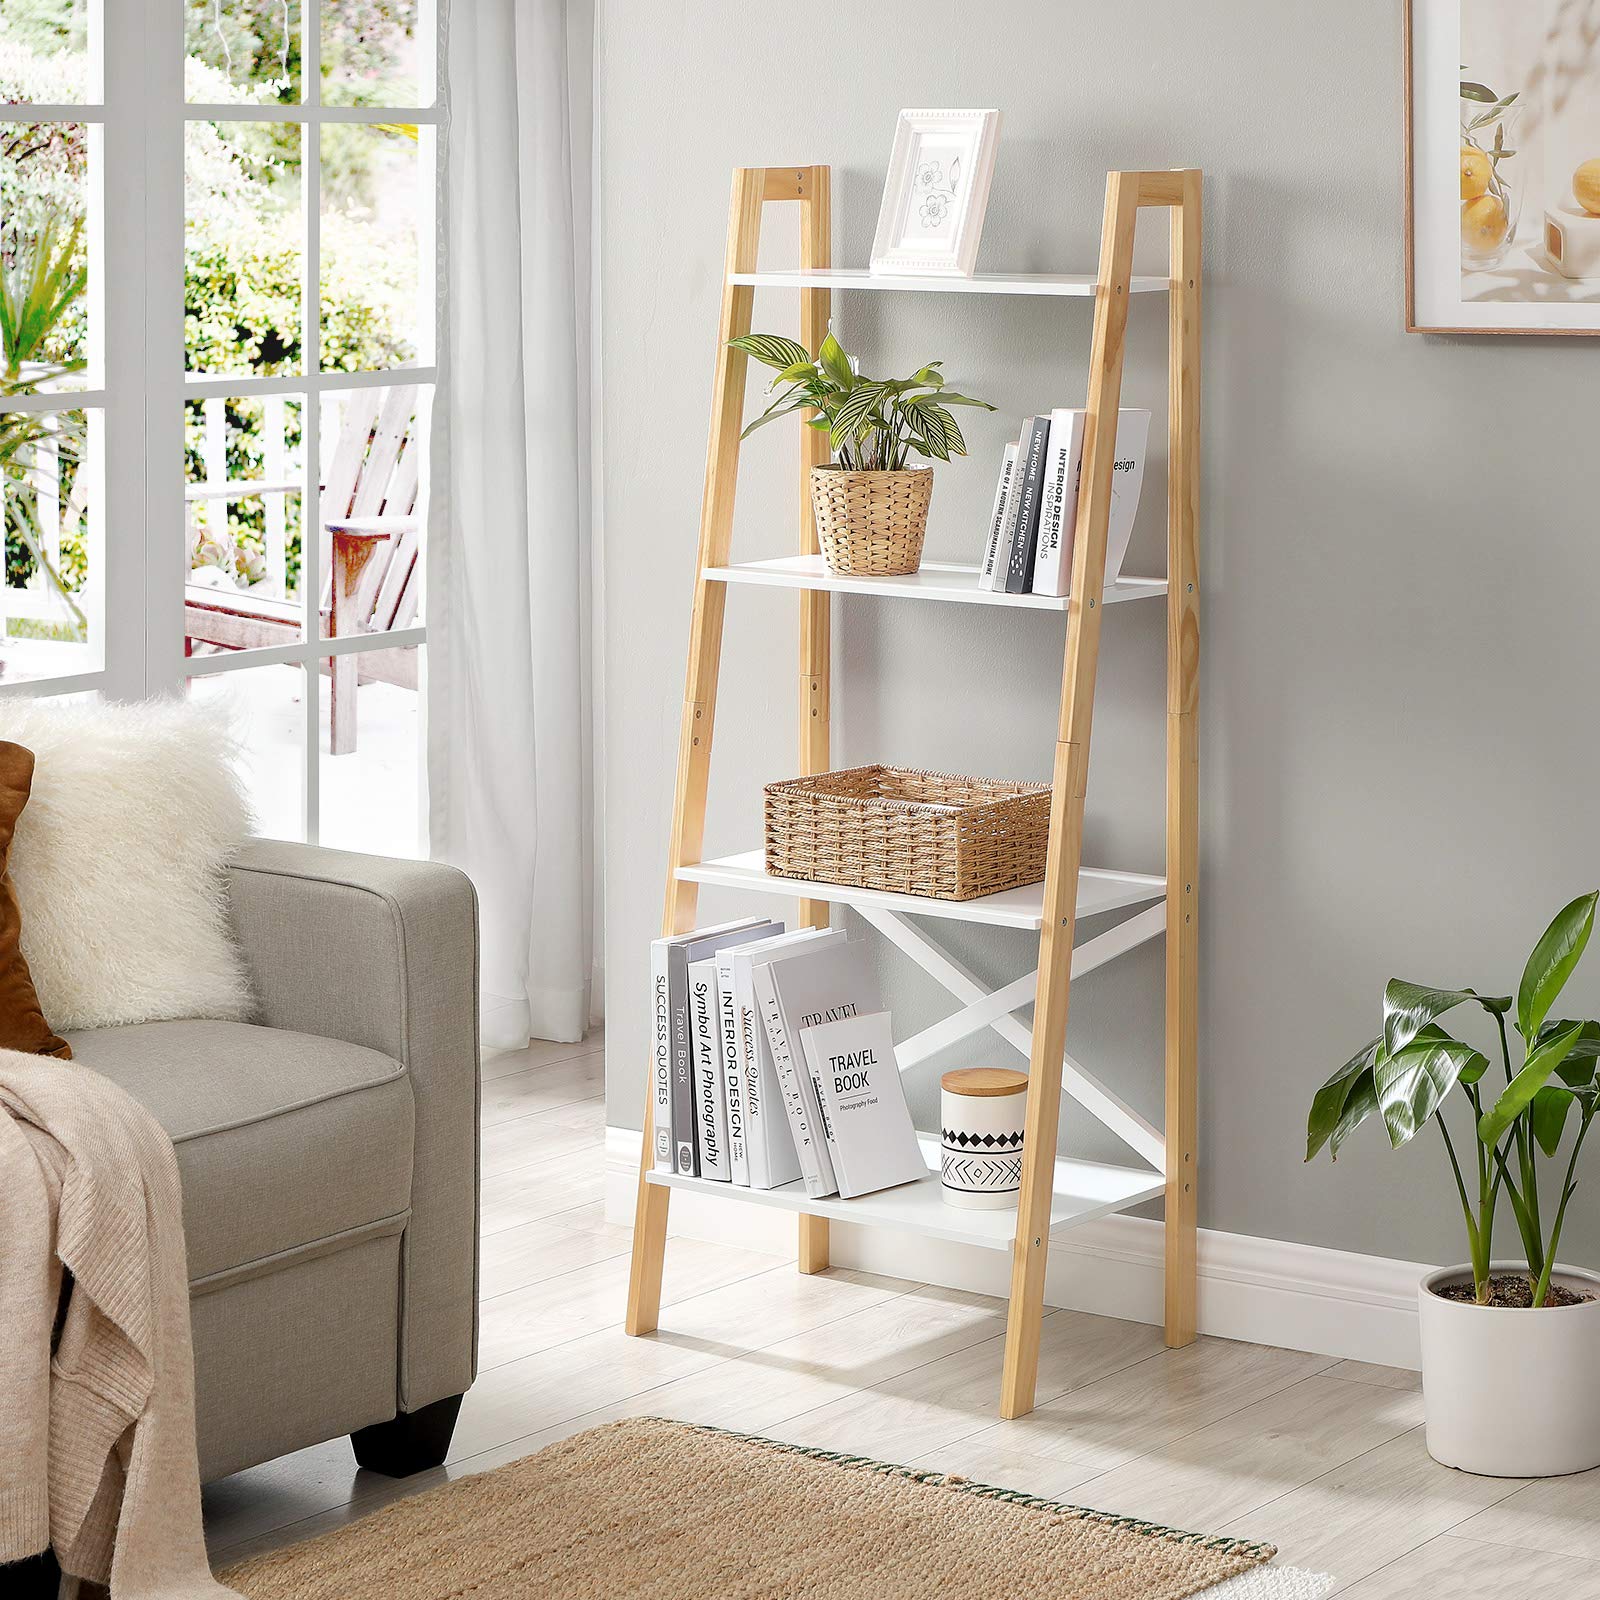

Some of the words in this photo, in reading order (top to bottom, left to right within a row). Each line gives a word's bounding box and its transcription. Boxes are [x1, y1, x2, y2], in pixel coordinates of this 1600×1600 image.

[1033, 430, 1042, 453] NEW
[1028, 453, 1038, 481] HOME
[1055, 448, 1067, 504] INTERIOR
[1113, 458, 1135, 472] esign
[1023, 486, 1033, 510] NEW
[1017, 509, 1029, 549] KITCHEN
[1040, 482, 1055, 560] INSPIRATIONS
[1050, 504, 1061, 549] DESIGN
[656, 975, 667, 1041] SUCCESS
[676, 1006, 686, 1044] Travel
[693, 982, 712, 1039] Symbol
[722, 991, 737, 1070] INTERIOR
[700, 1042, 712, 1065] Art
[742, 1005, 754, 1062] Success
[656, 1045, 668, 1105] QUOTES
[678, 1050, 687, 1083] Book
[768, 998, 793, 1076] TRAVEL
[792, 1092, 811, 1145] BOOK
[829, 1049, 877, 1073] TRAVEL
[834, 1071, 870, 1093] BOOK
[728, 1076, 742, 1138] DESIGN
[744, 1065, 760, 1116] Quotes
[840, 1099, 867, 1112] Photography
[867, 1097, 878, 1106] Food
[702, 1069, 719, 1167] Photography
